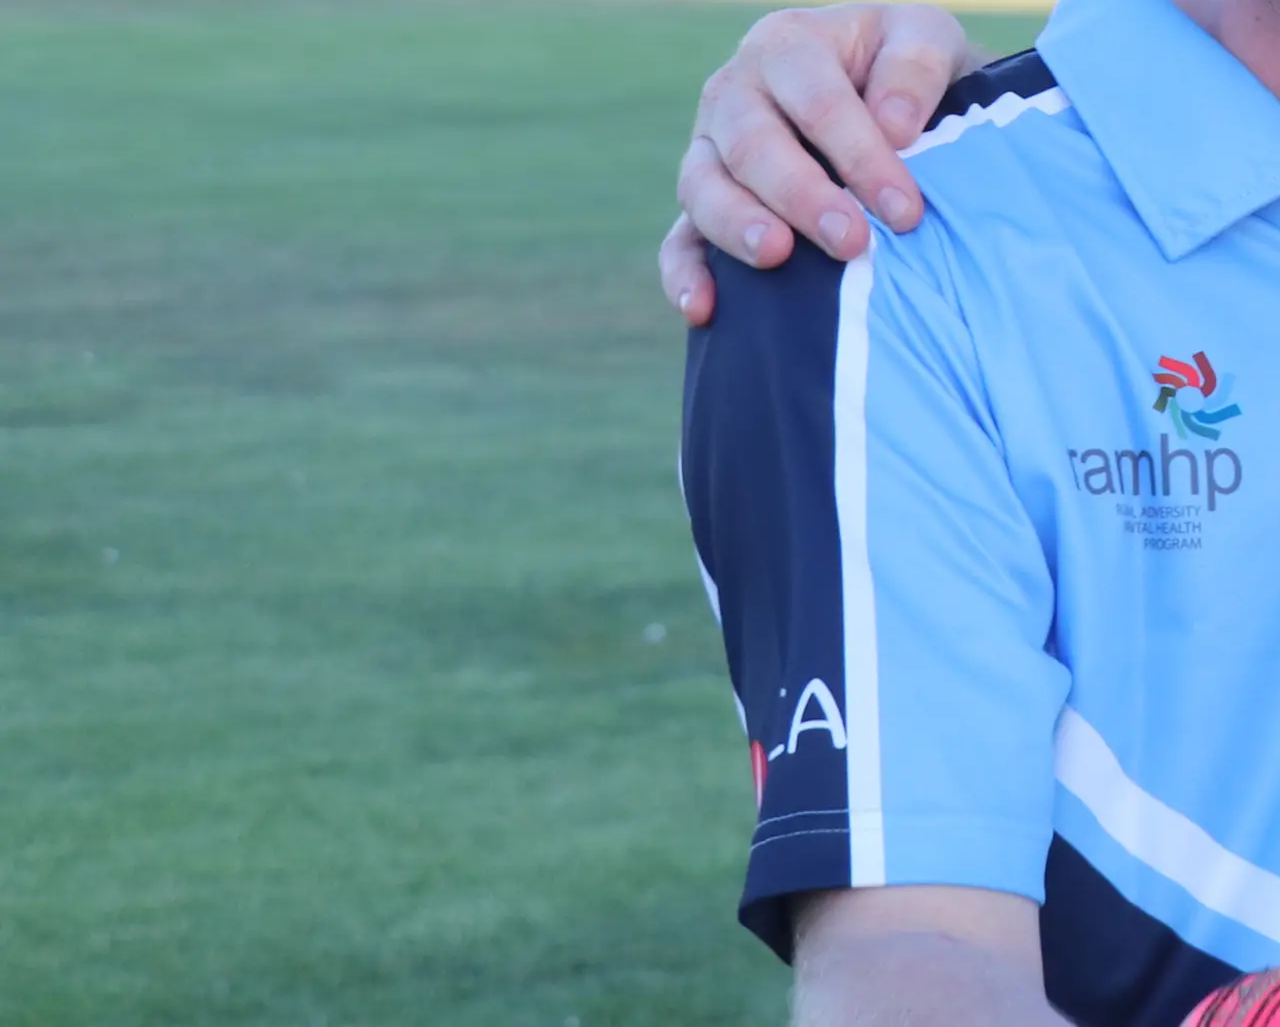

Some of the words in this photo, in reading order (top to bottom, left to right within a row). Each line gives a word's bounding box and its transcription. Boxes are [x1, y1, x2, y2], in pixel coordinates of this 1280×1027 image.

[1067, 432, 1243, 512] ramhp
[1140, 504, 1202, 520] ADVERSITY
[1156, 521, 1202, 535] HEALTH
[1143, 537, 1203, 552] PROGRAM
